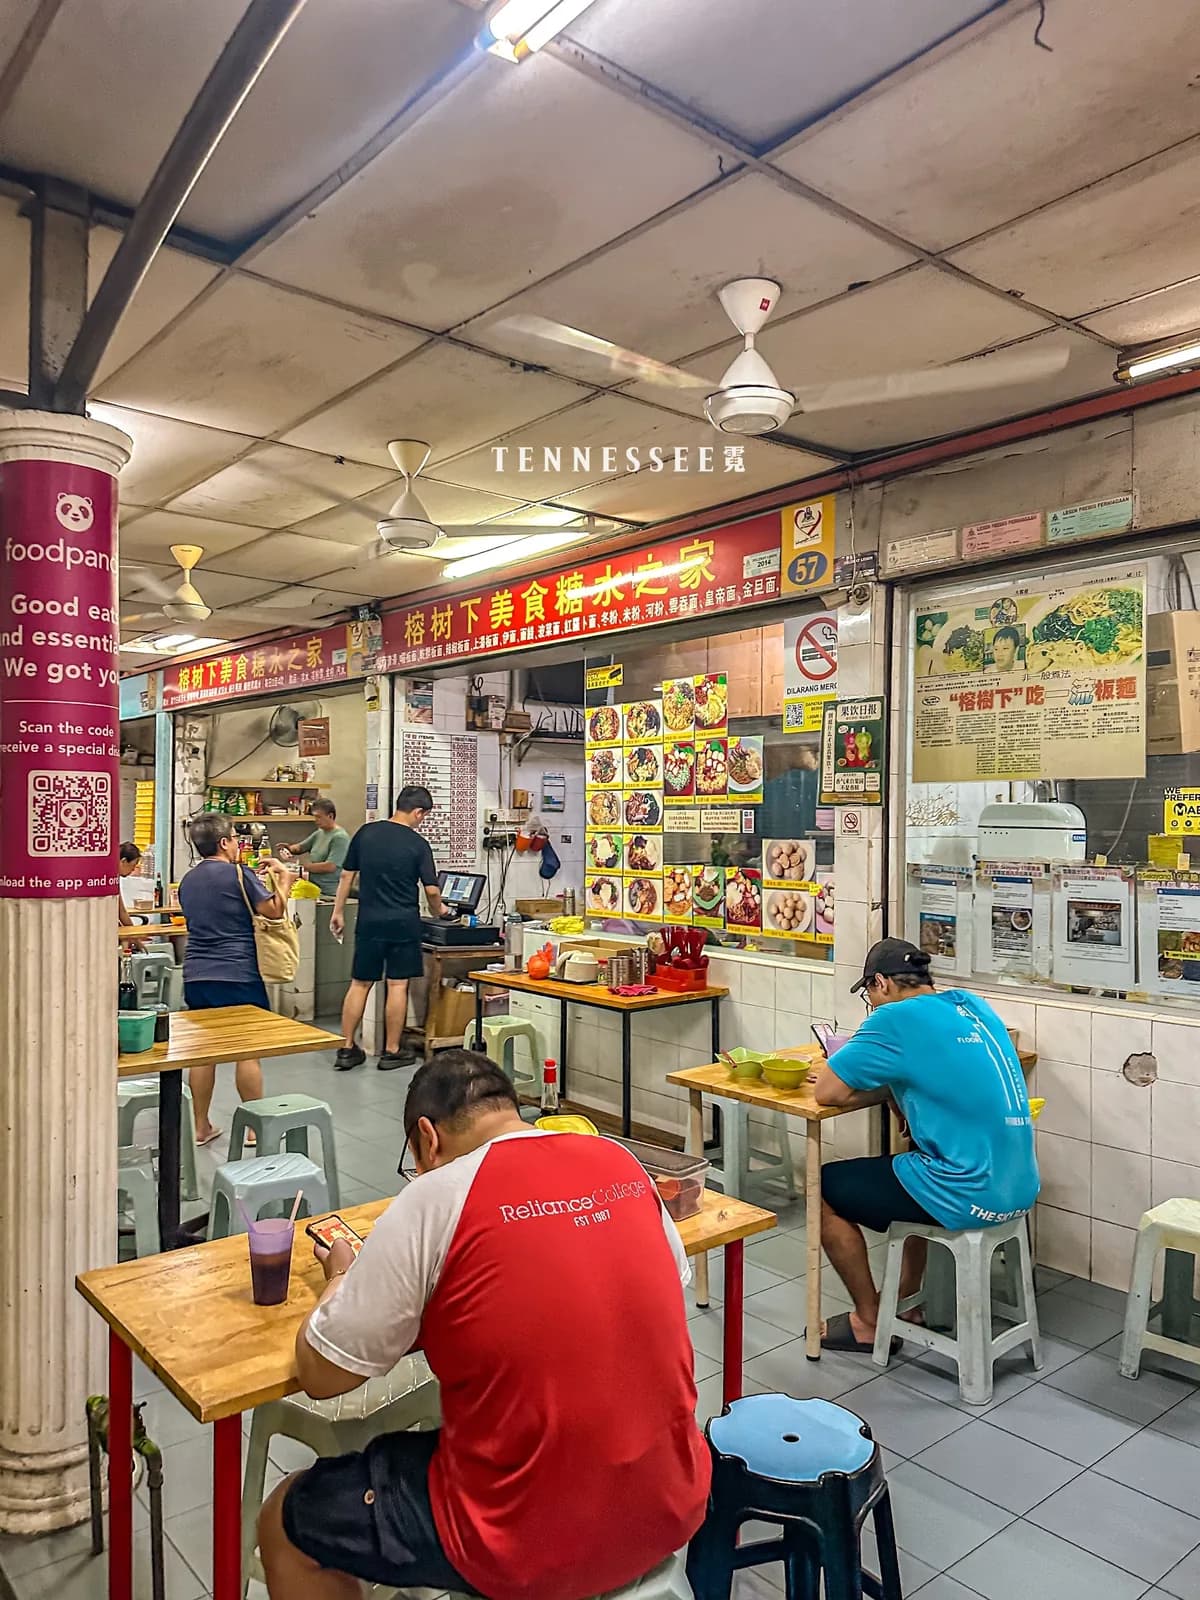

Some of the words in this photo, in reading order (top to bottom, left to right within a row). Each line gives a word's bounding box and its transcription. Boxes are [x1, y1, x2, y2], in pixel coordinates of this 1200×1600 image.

[795, 555, 819, 584] 57
[11, 594, 79, 616] Good
[0, 624, 23, 647] nd
[32, 622, 119, 656] essentia
[4, 657, 38, 678] We
[47, 662, 92, 686] got
[786, 685, 819, 696] DILARANG
[840, 703, 878, 717] 果饮日报
[19, 721, 53, 733] Scan
[57, 721, 84, 735] the
[87, 724, 114, 737] code
[44, 744, 53, 753] a
[58, 742, 106, 757] special
[29, 876, 52, 888] the
[56, 879, 84, 890] app
[87, 875, 107, 888] and
[573, 1215, 590, 1228] EST
[591, 1208, 611, 1224] 1987
